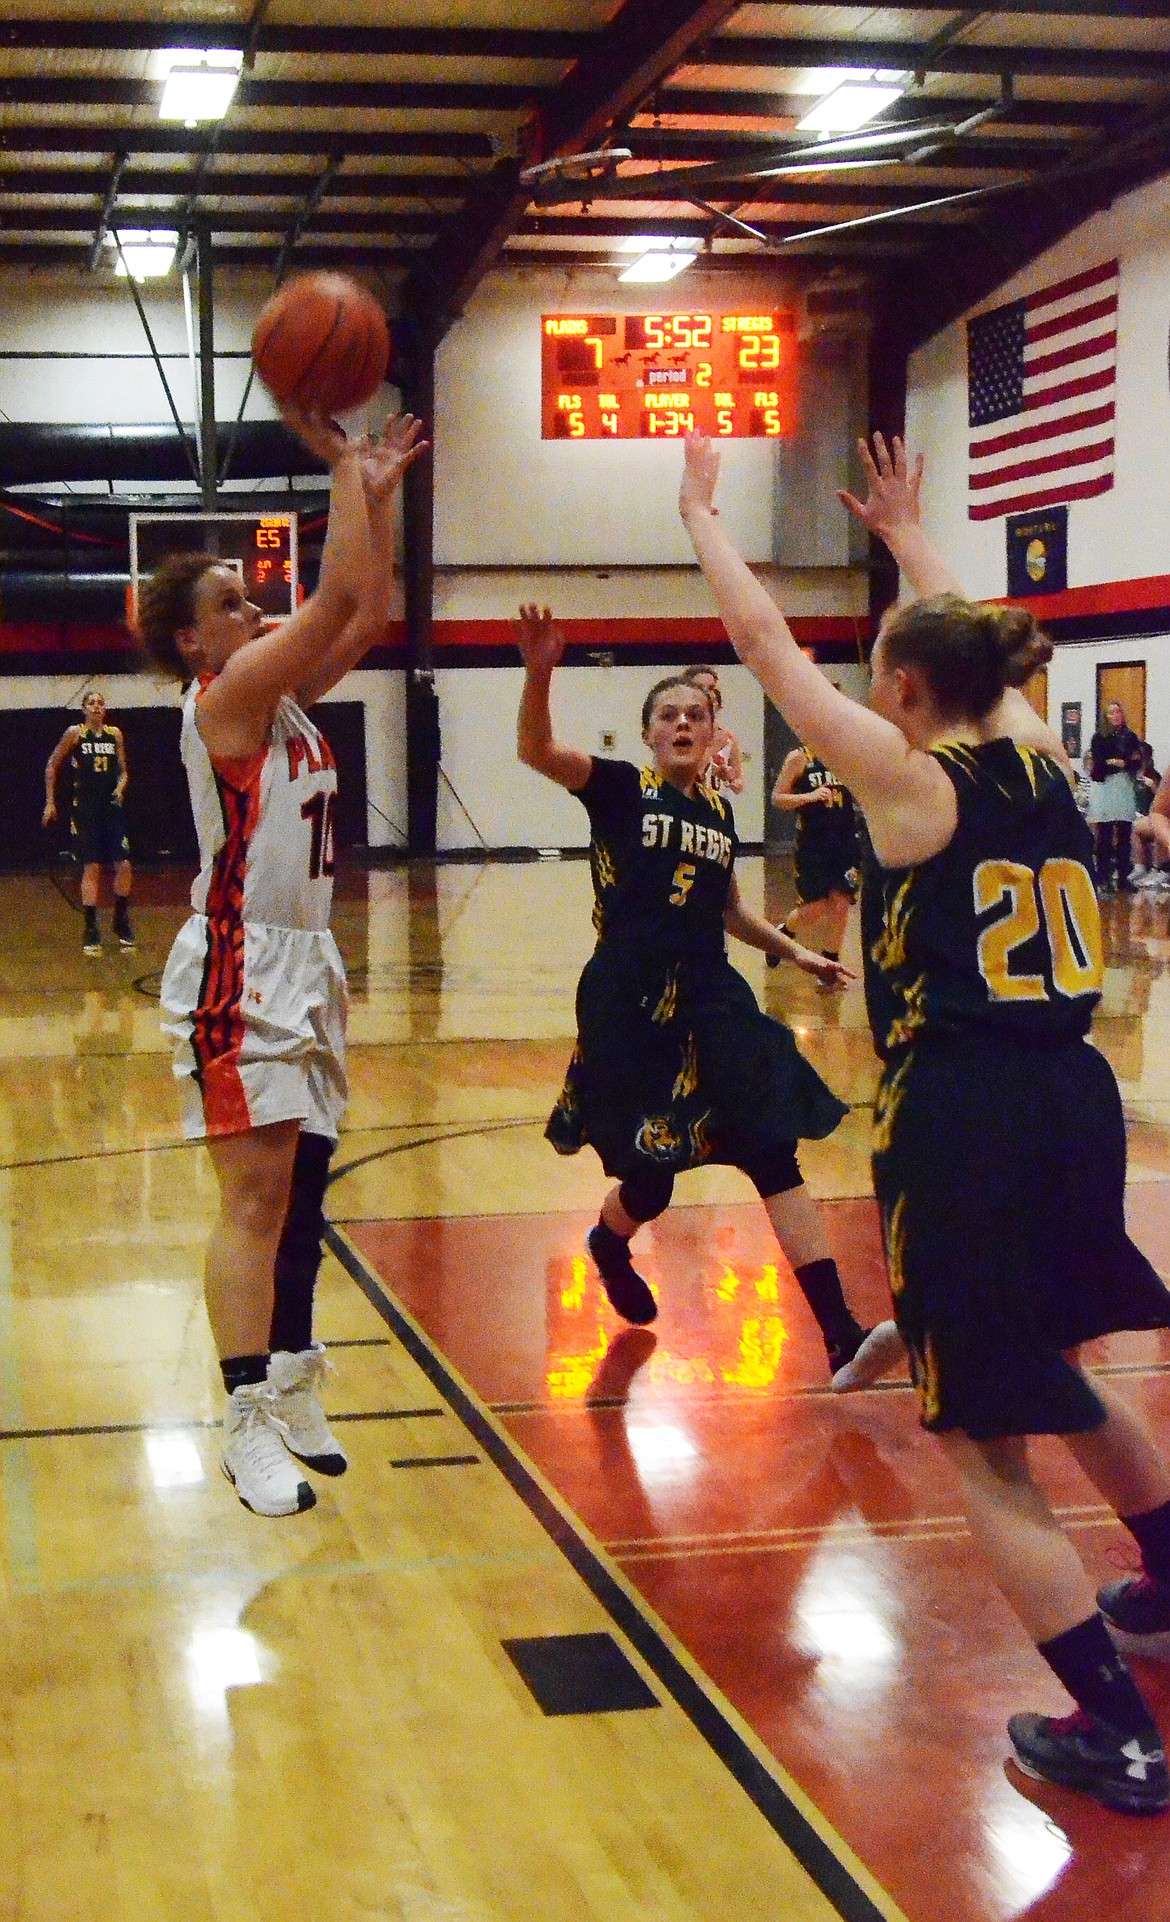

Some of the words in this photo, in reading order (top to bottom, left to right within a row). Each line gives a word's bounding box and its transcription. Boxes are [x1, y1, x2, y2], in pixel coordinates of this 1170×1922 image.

[644, 315, 712, 348] 5:52
[584, 337, 603, 369] 7
[739, 334, 780, 369] 23
[649, 368, 687, 386] period
[695, 362, 713, 387] 2
[644, 393, 690, 408] PLAYER
[569, 412, 585, 437] 5
[601, 413, 618, 434] 4
[649, 411, 694, 435] 1-34
[717, 410, 733, 434] 5
[764, 410, 781, 434] 5
[642, 813, 674, 849] ST
[680, 819, 732, 869] REGIS
[669, 862, 696, 907] 5
[973, 857, 1104, 1002] 20
